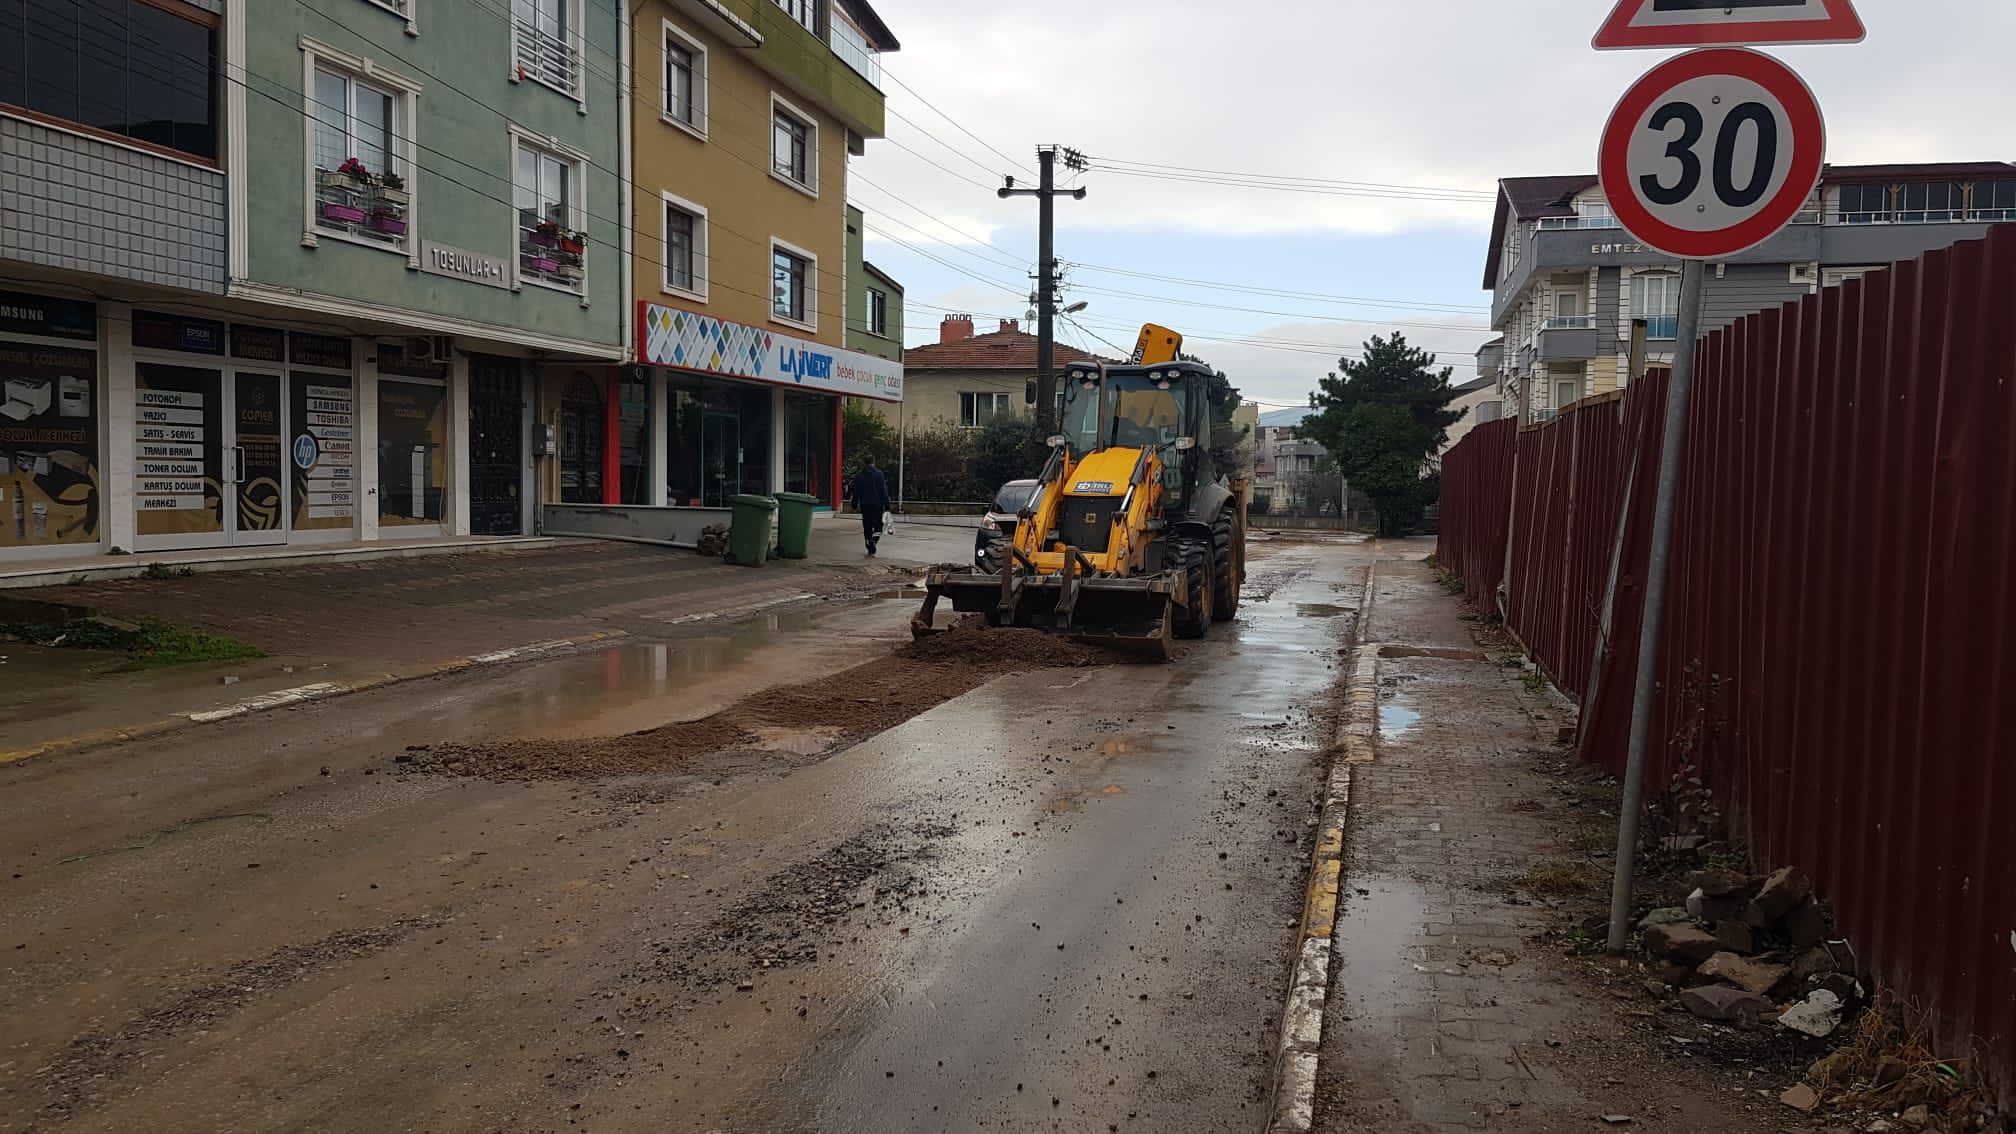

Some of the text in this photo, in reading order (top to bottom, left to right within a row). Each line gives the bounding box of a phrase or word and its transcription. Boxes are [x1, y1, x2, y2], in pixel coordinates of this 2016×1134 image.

[1639, 101, 1777, 207] 30
[1591, 243, 1641, 254] EMTEZ
[837, 362, 855, 380] bebek
[313, 400, 350, 411] SAMSUNG
[316, 414, 350, 425] TOSHIBA
[324, 440, 350, 451] Canon
[169, 447, 193, 456] BAKIM
[298, 437, 313, 467] hp
[144, 464, 198, 474] TONER DOLUM
[175, 482, 201, 490] DOLUM
[331, 493, 350, 501] EPSON
